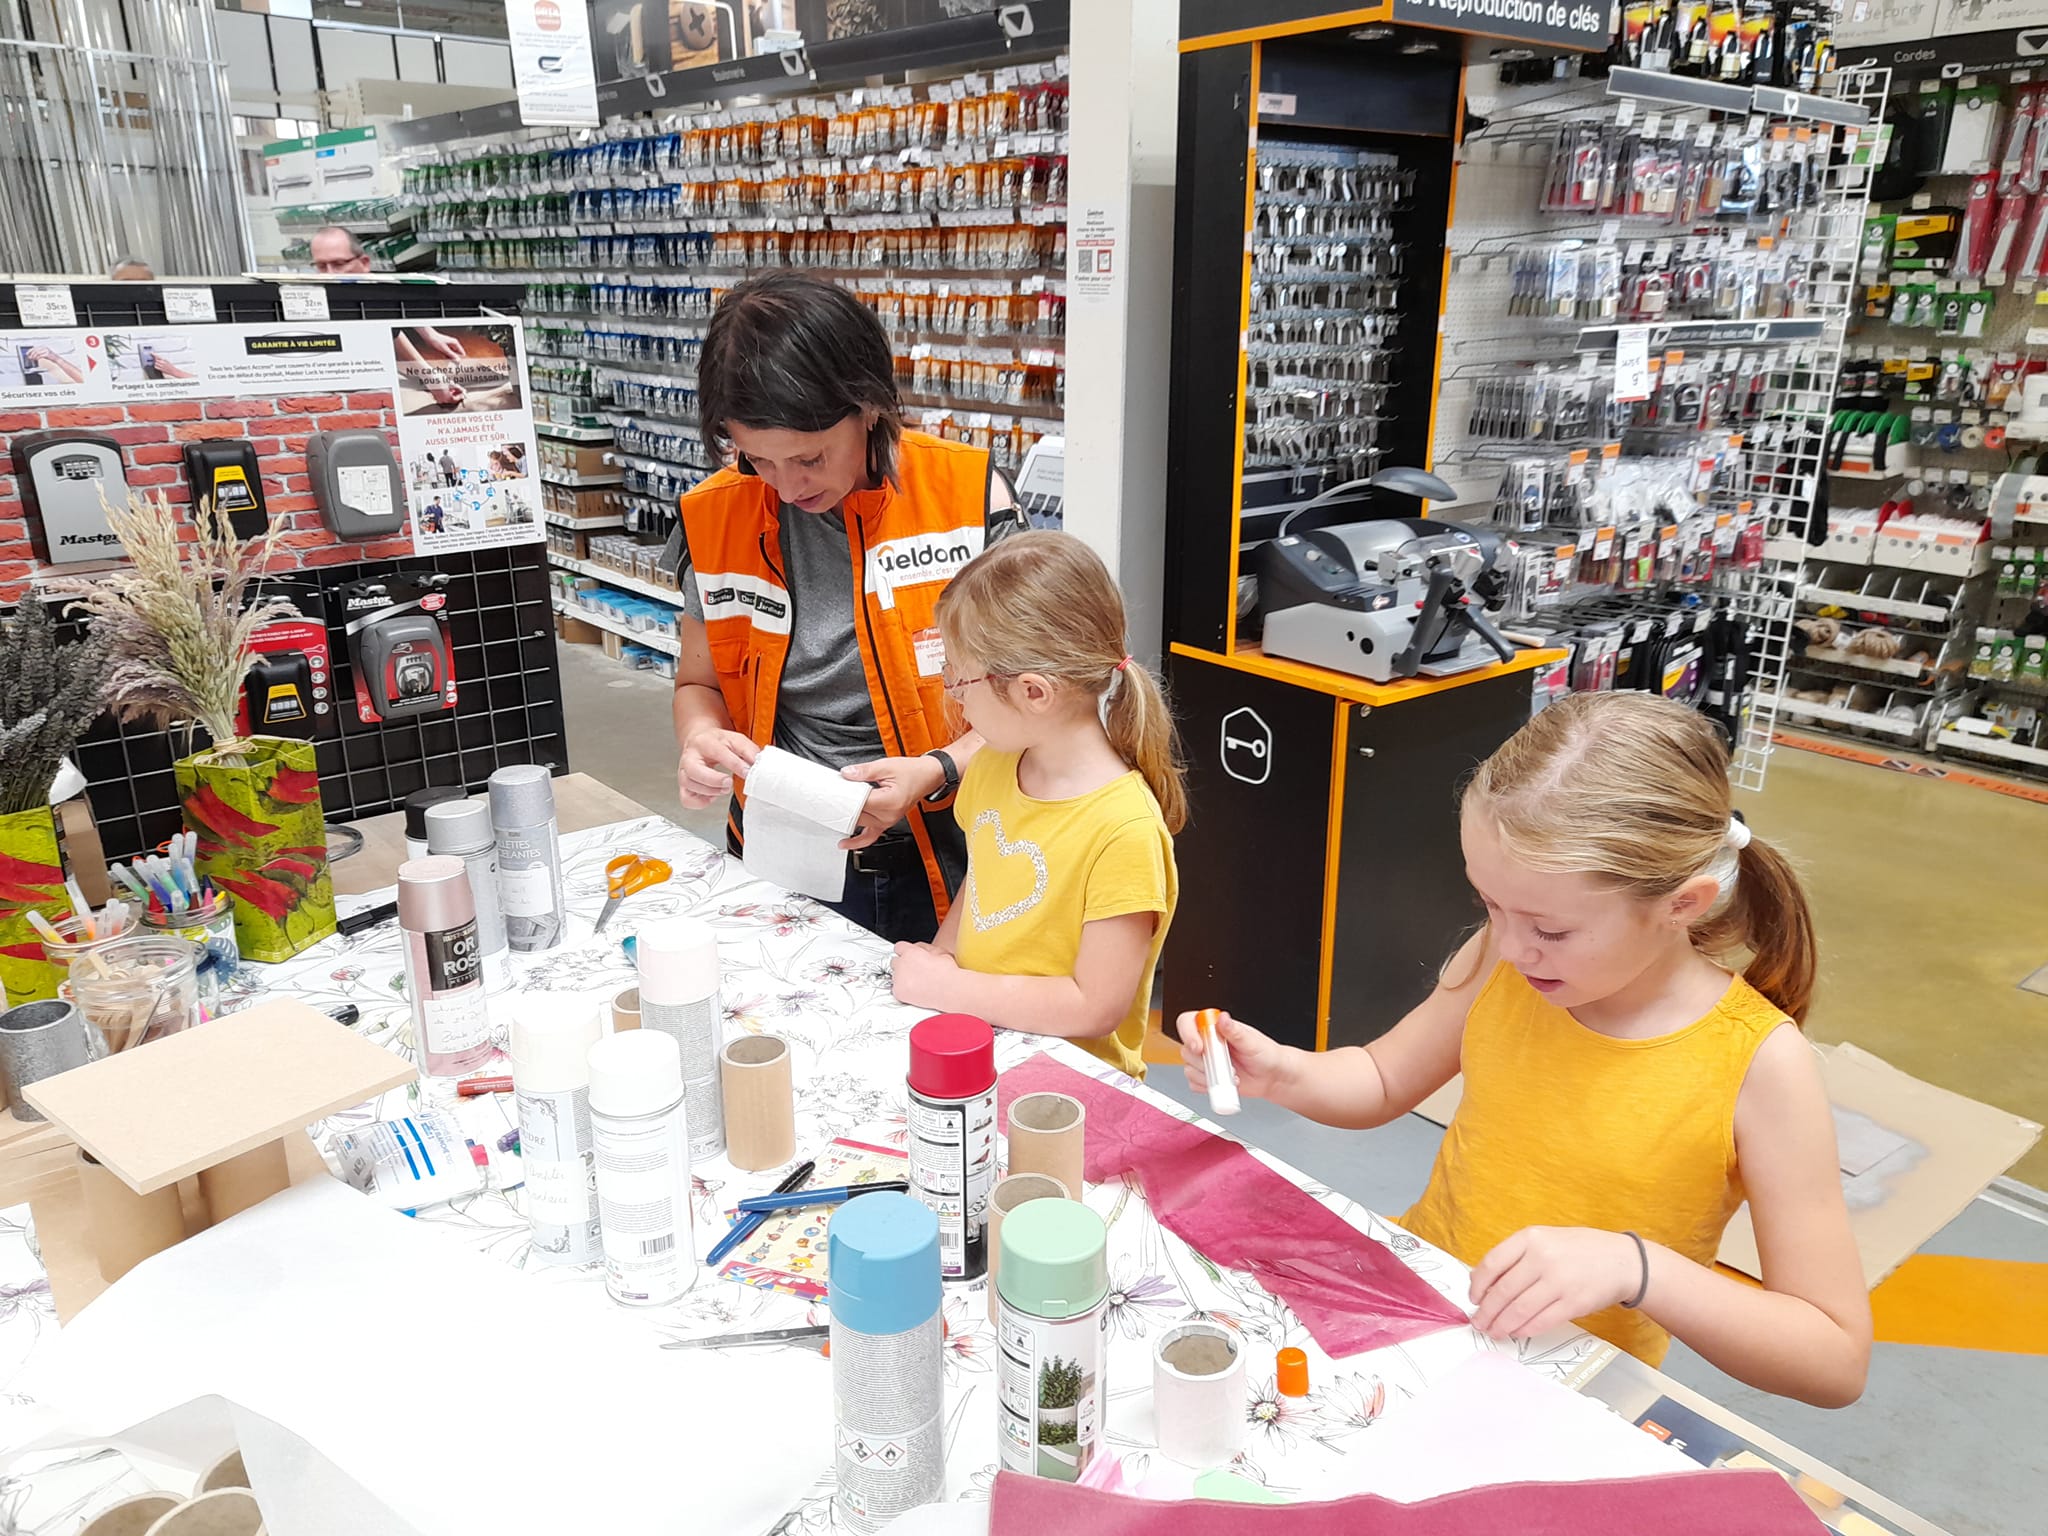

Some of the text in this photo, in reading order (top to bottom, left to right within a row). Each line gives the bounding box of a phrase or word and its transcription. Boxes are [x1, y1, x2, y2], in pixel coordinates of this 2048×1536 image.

[1545, 3, 1566, 27] de
[1569, 4, 1601, 33] clés
[1893, 49, 1937, 63] Cordes
[251, 338, 337, 349] GARANTIE À VIE LIMITÉE
[406, 367, 419, 375] Ne
[421, 365, 453, 375] cachez
[455, 365, 475, 374] plus
[493, 363, 512, 371] clés
[419, 377, 441, 385] sous
[442, 375, 450, 384] le
[453, 373, 500, 385] paillasson
[112, 382, 145, 391] Partagez
[155, 380, 201, 389] combinaison
[1, 391, 41, 400] Sécurisez
[58, 389, 76, 397] clés
[426, 413, 504, 425] PARTAGER VOS CLÉS
[437, 424, 496, 435] N'A JAMAIS ÉTÉ
[425, 438, 449, 446] AUSSI
[449, 436, 478, 444] SIMPLE
[479, 435, 489, 443] ET
[490, 432, 506, 442] SÛR
[60, 533, 119, 545] Master
[347, 596, 392, 608] Master
[453, 935, 475, 956] OR
[443, 949, 481, 976] ROSE
[940, 1202, 958, 1212] A+
[1009, 1422, 1027, 1438] A+
